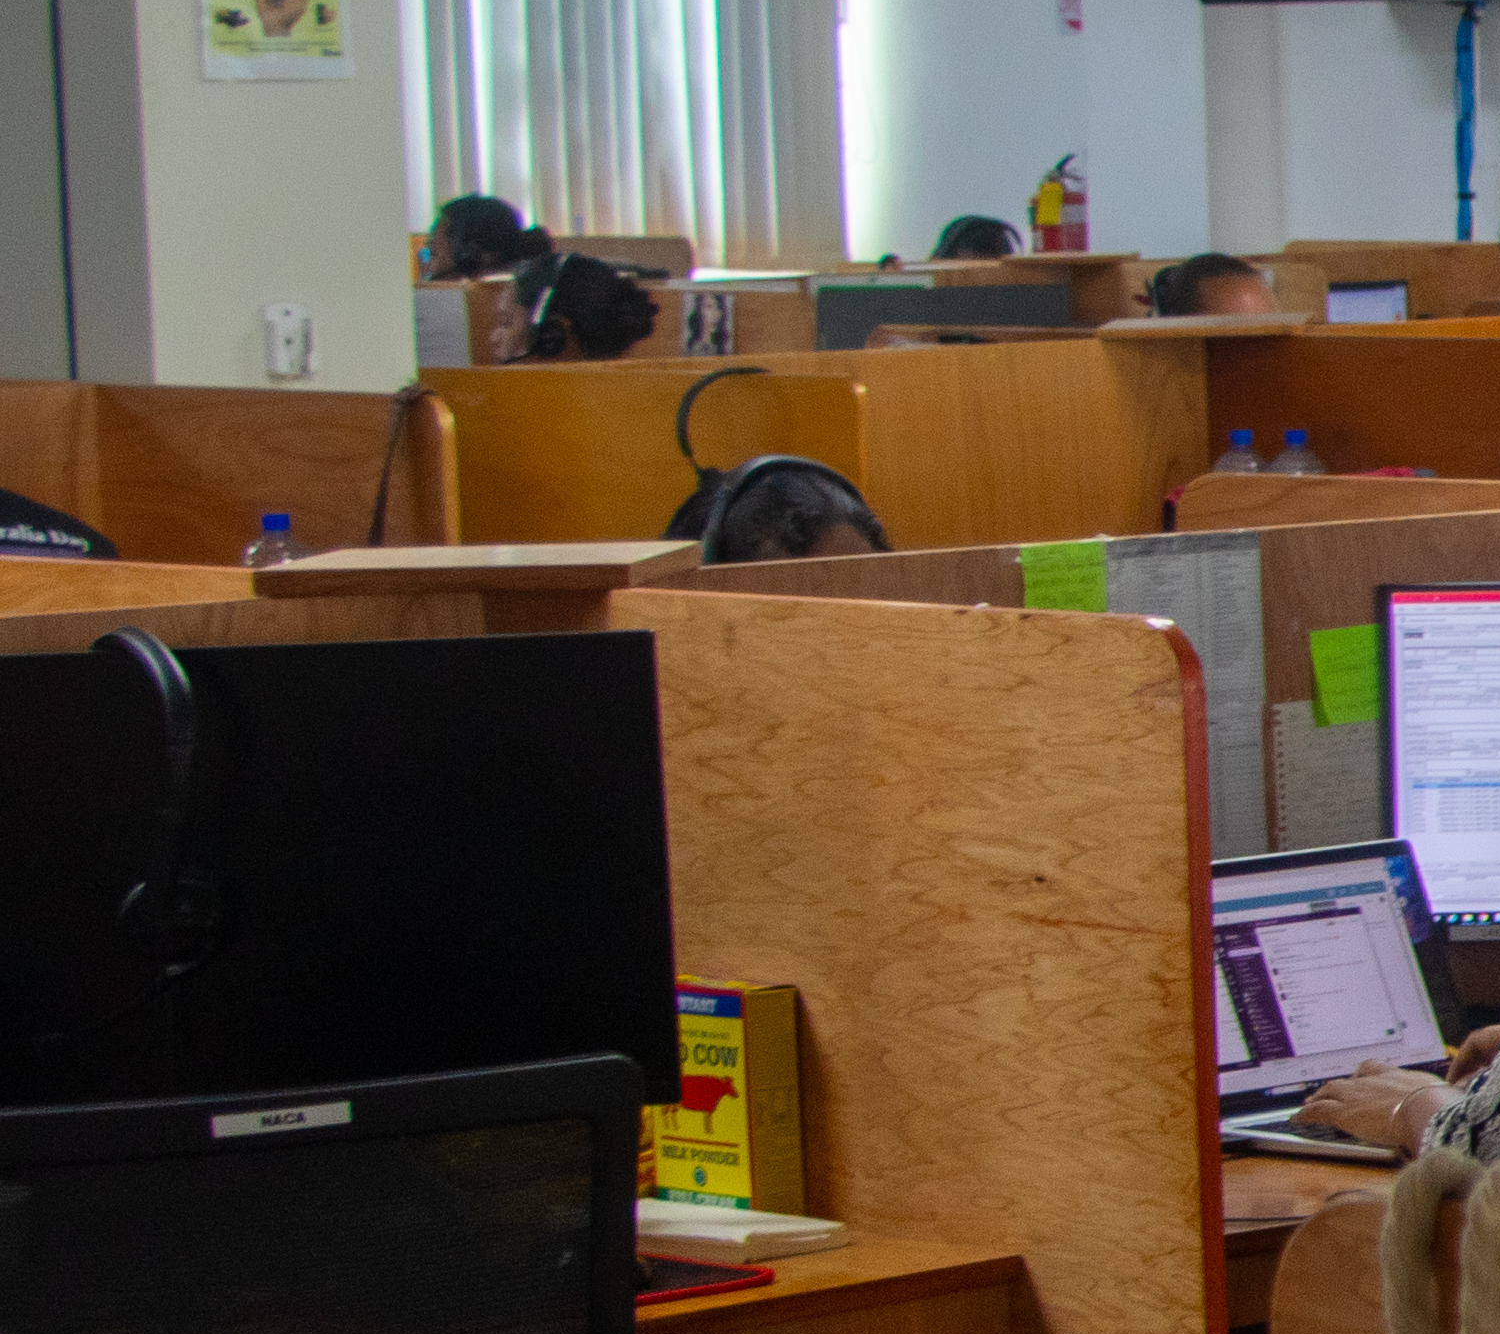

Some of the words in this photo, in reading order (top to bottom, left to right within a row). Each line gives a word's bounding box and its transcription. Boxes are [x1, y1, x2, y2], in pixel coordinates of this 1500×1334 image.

[48, 529, 91, 553] Day
[693, 1044, 739, 1067] COW
[690, 1148, 741, 1166] POWDER
